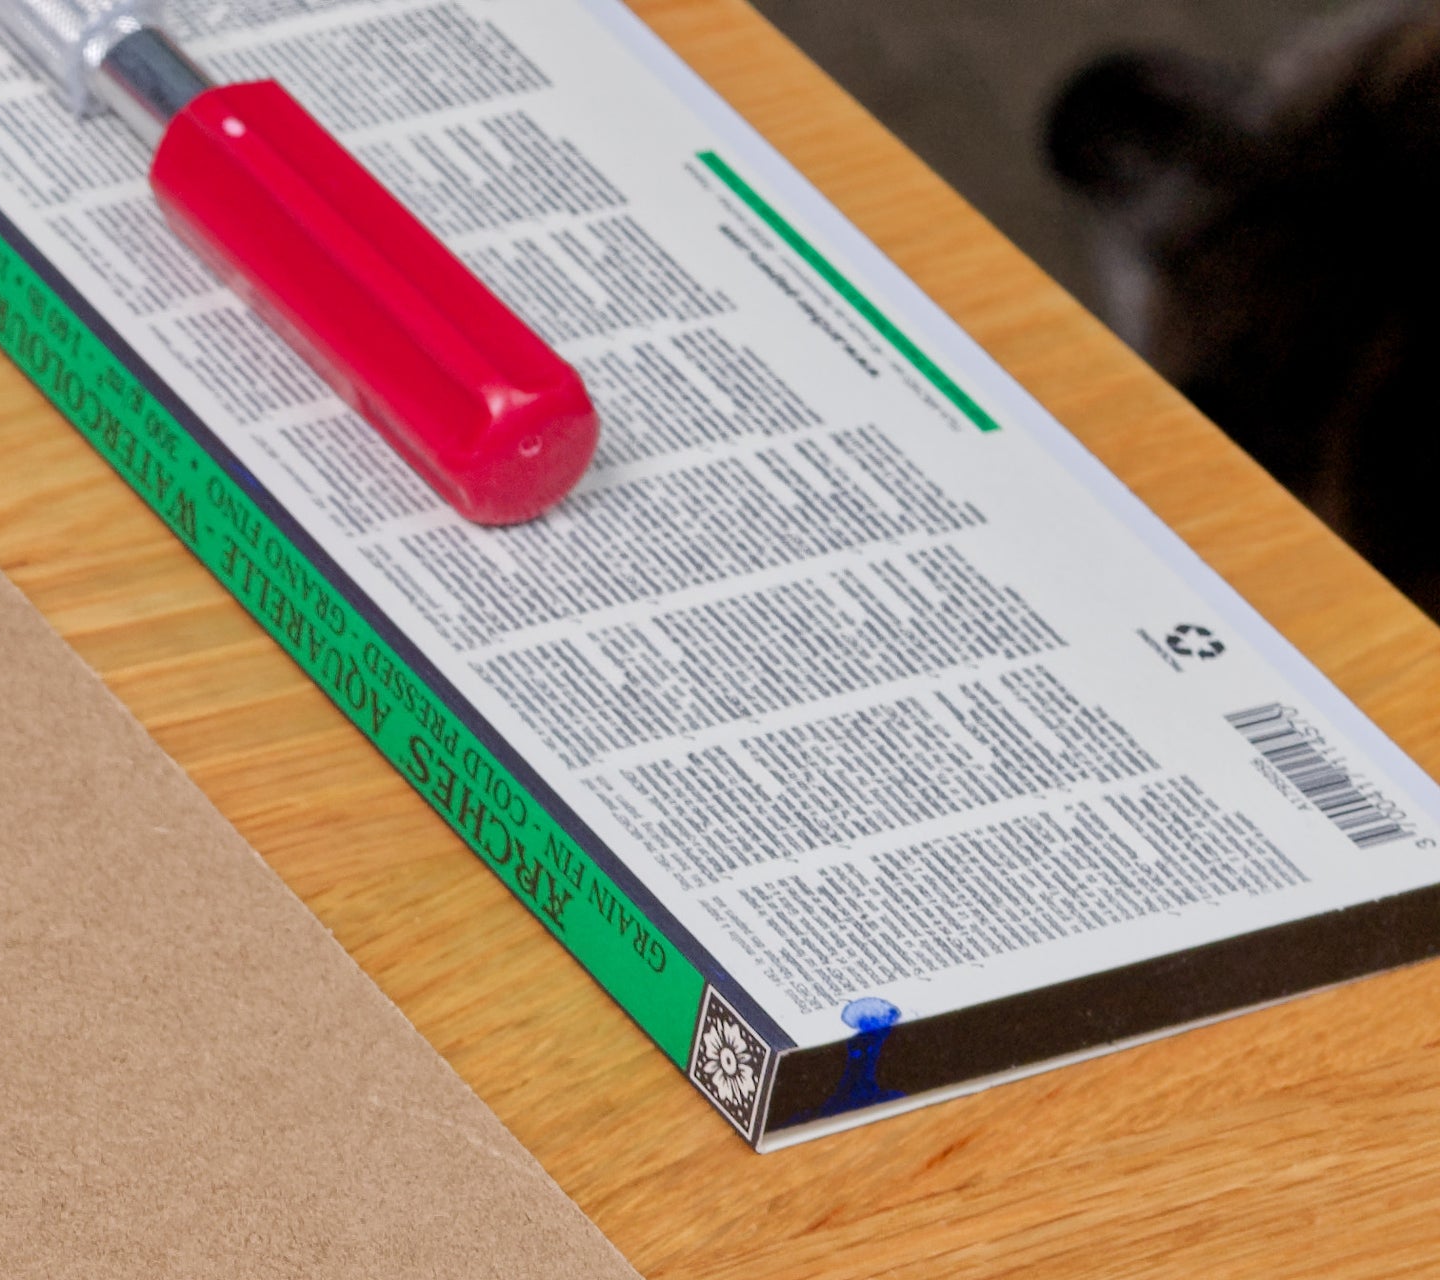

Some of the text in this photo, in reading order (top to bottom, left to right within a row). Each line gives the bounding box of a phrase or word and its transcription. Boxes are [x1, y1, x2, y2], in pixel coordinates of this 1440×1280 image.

[207, 475, 261, 549] FINO
[220, 533, 391, 734] AQUARELLE
[265, 539, 346, 636] GRANO
[364, 642, 459, 755] PRESSED
[463, 753, 528, 828] COLD
[543, 833, 586, 891] FIN
[588, 876, 667, 974] GRAIN
